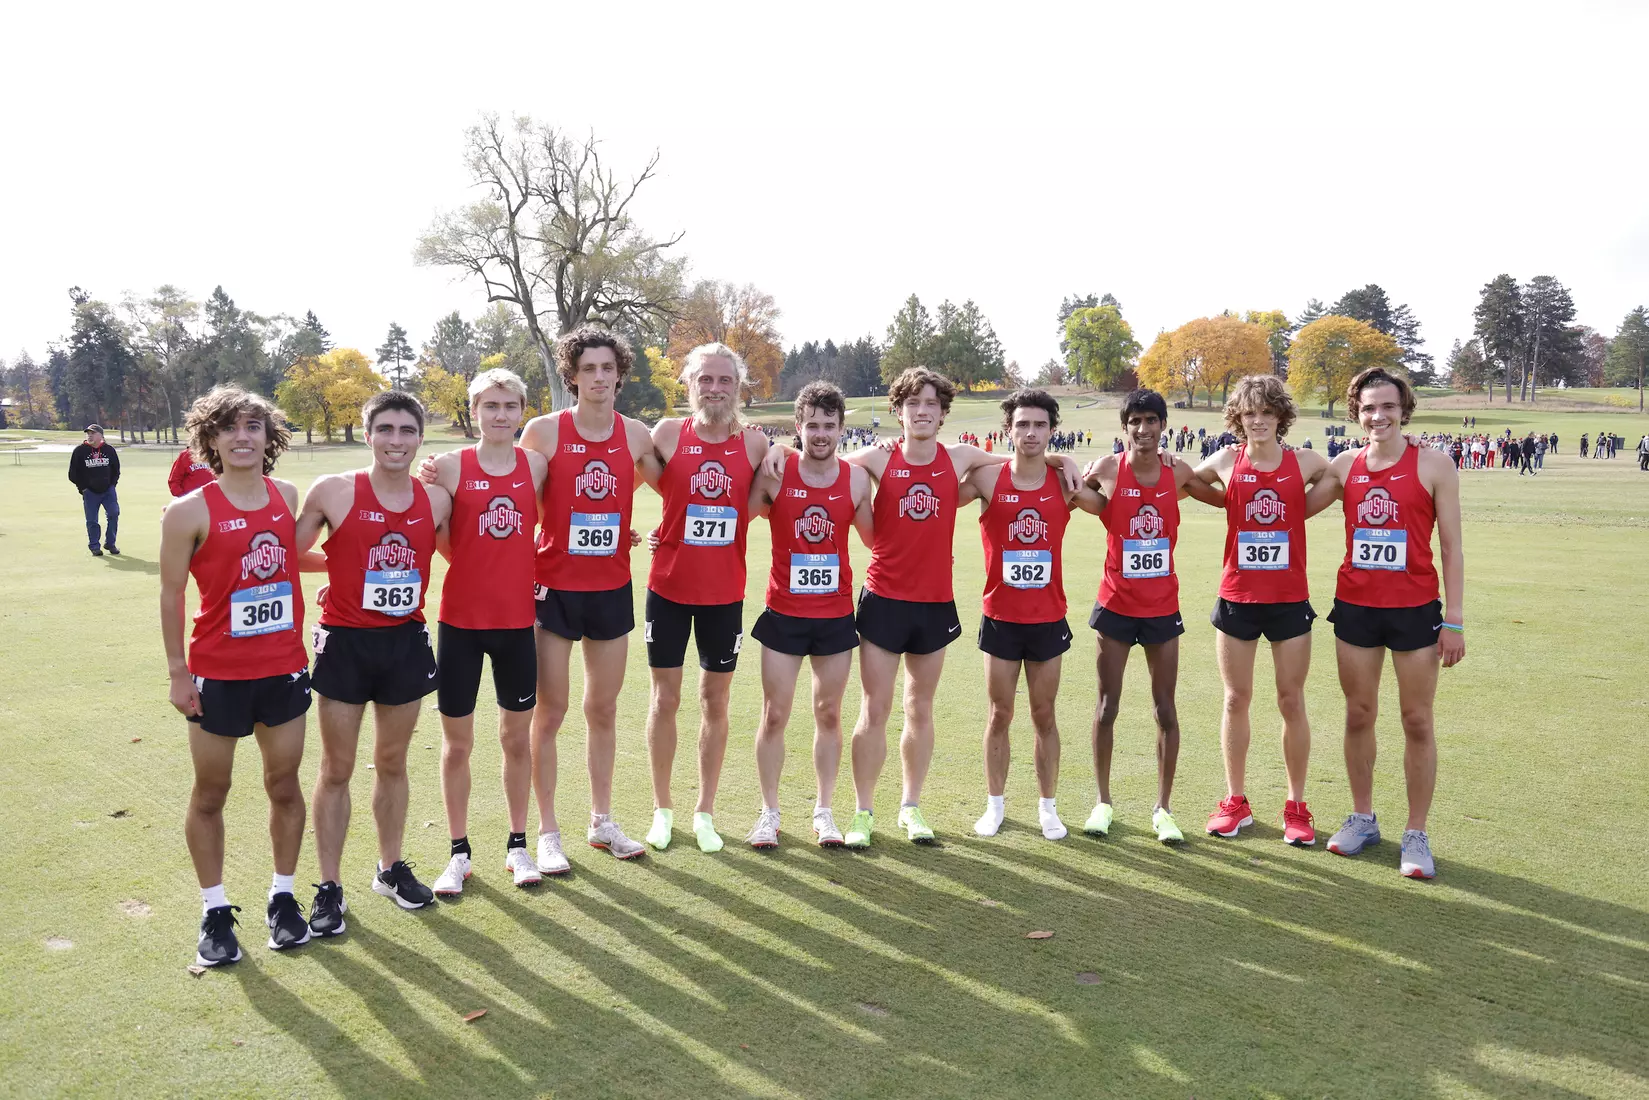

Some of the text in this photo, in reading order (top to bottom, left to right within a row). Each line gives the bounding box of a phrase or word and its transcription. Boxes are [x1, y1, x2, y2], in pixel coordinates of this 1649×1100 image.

[575, 470, 617, 497] OHIO STATE
[691, 470, 732, 498] OHIO STATE
[900, 493, 940, 518] OHIO STATE
[1246, 498, 1286, 522] OHIO STATE
[1357, 497, 1398, 523] OHIO STATE
[479, 506, 522, 536] OHIO STATE
[693, 520, 726, 538] 371
[795, 515, 835, 541] OHIO STATE
[1009, 518, 1048, 541] OHIO STATE
[578, 529, 612, 546] 369
[241, 544, 286, 580] OHIO STATE
[368, 543, 416, 570] OHIO STATE
[1130, 553, 1162, 570] 366
[1246, 546, 1281, 562] 367
[1360, 544, 1396, 562] 370
[798, 569, 832, 585] 365
[1011, 565, 1044, 580] 362
[373, 587, 414, 607] 363
[243, 600, 283, 626] 360
